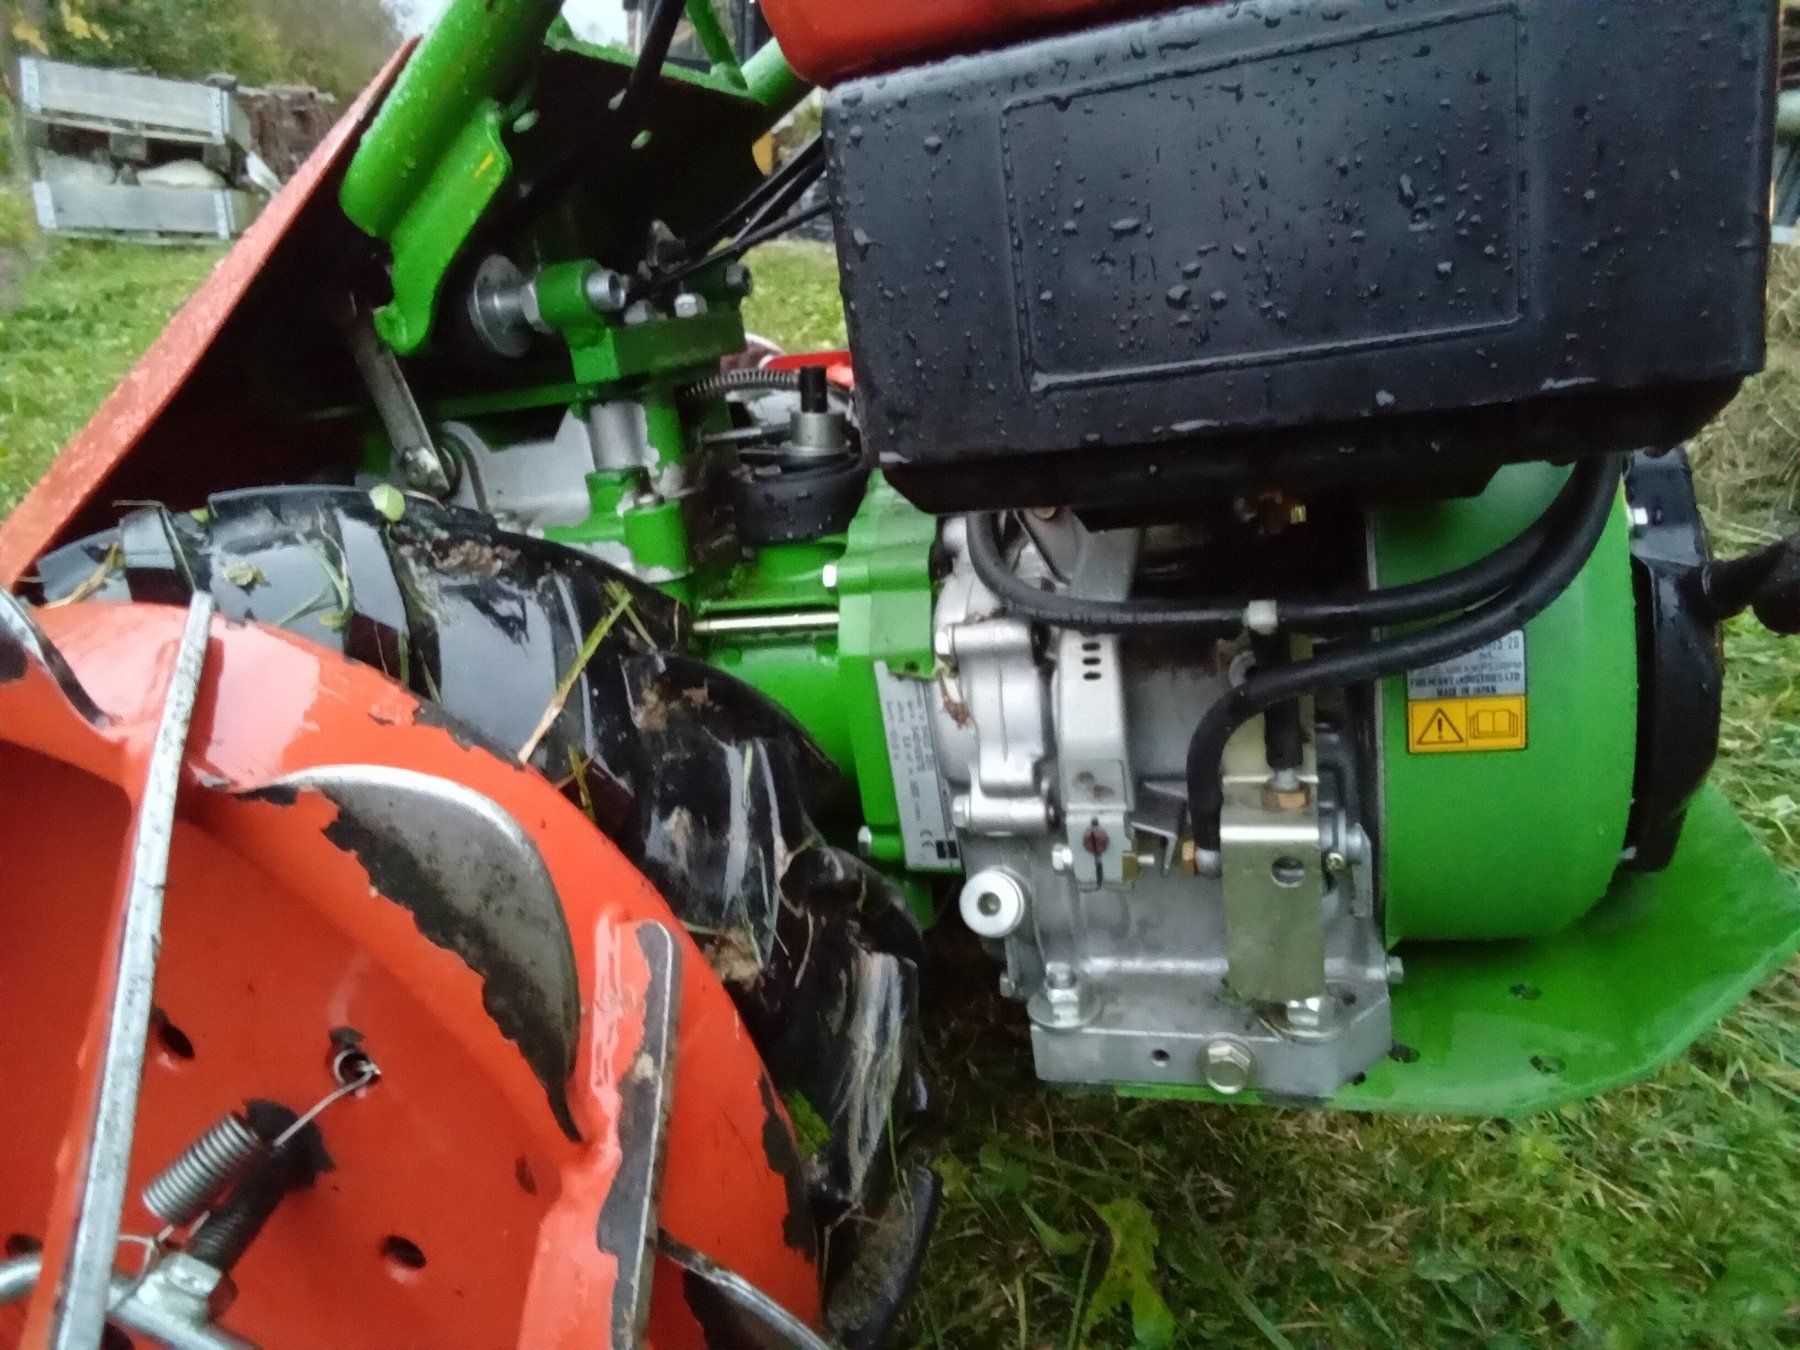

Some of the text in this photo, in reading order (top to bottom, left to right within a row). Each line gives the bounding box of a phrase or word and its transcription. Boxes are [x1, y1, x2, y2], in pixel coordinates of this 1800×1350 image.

[1437, 685, 1496, 697] MADE IN JAPAN
